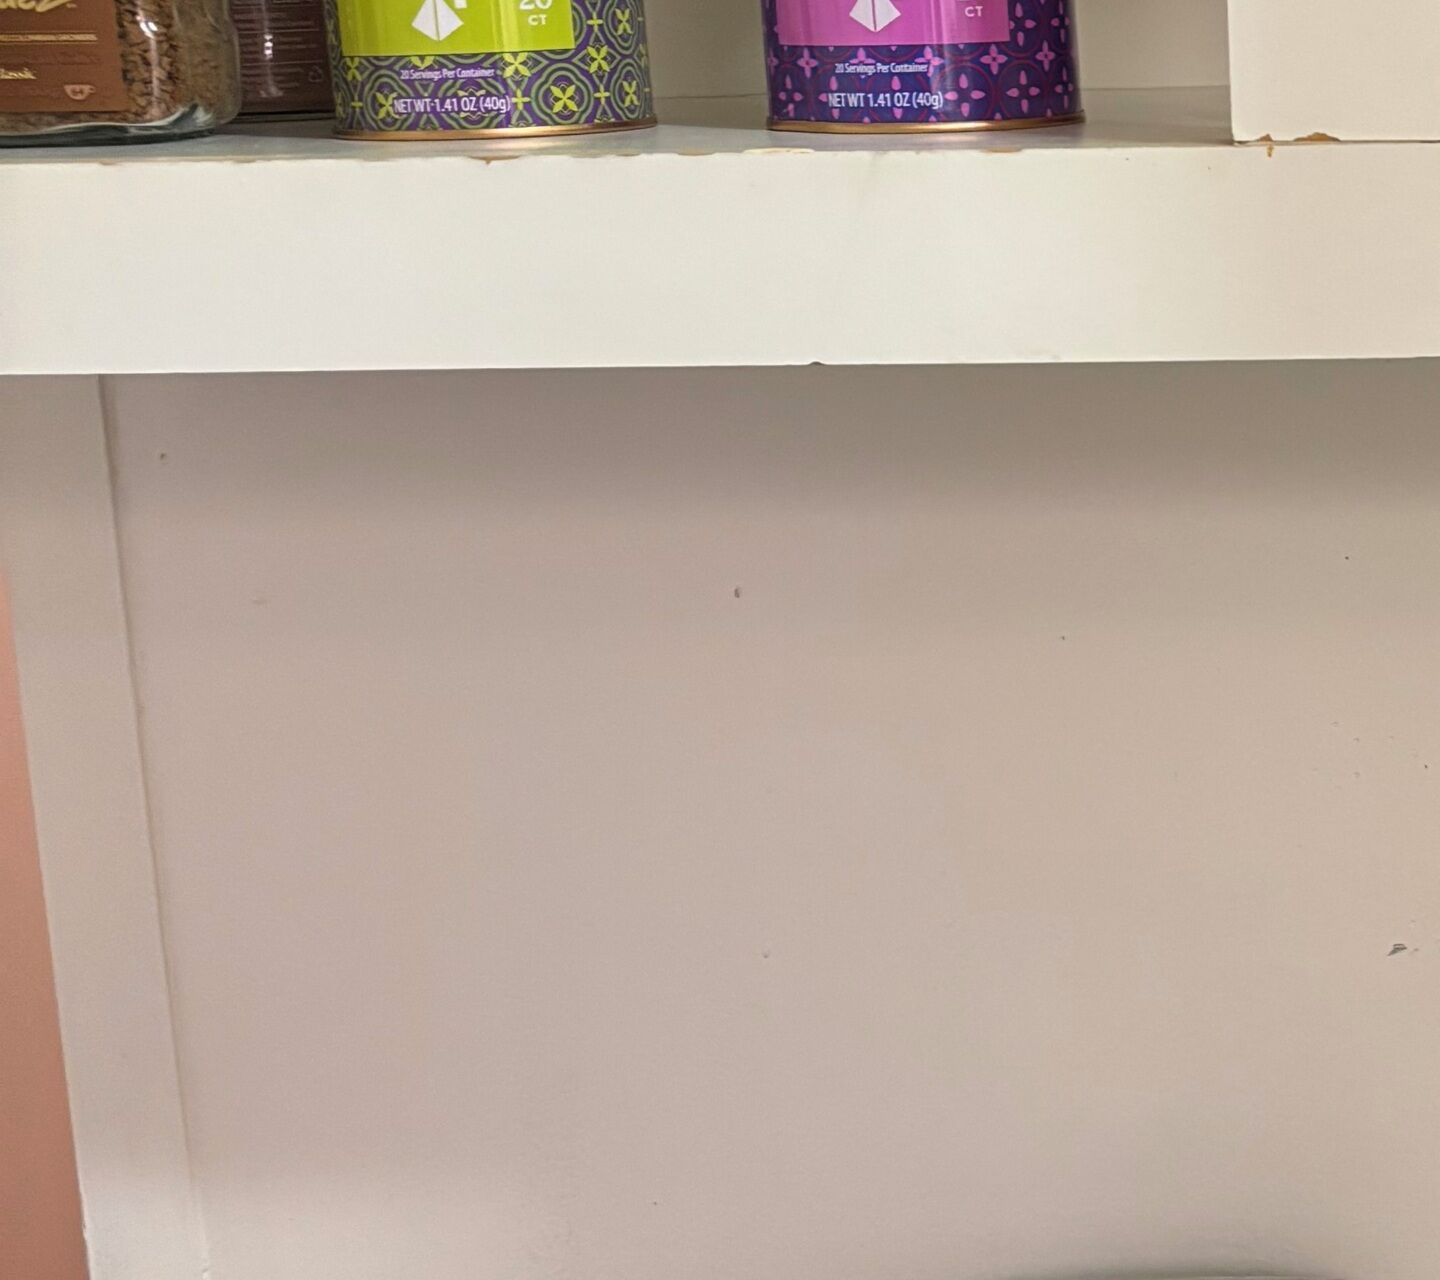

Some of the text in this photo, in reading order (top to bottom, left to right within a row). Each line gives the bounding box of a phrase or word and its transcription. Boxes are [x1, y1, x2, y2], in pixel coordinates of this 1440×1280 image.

[964, 5, 984, 17] CT
[527, 14, 548, 26] CT
[442, 67, 456, 79] Per
[876, 62, 890, 74] Per
[393, 95, 511, 114] NET WT 1.41 OZ (40g)
[828, 90, 944, 110] NET WT 1.41 OZ (40g)
